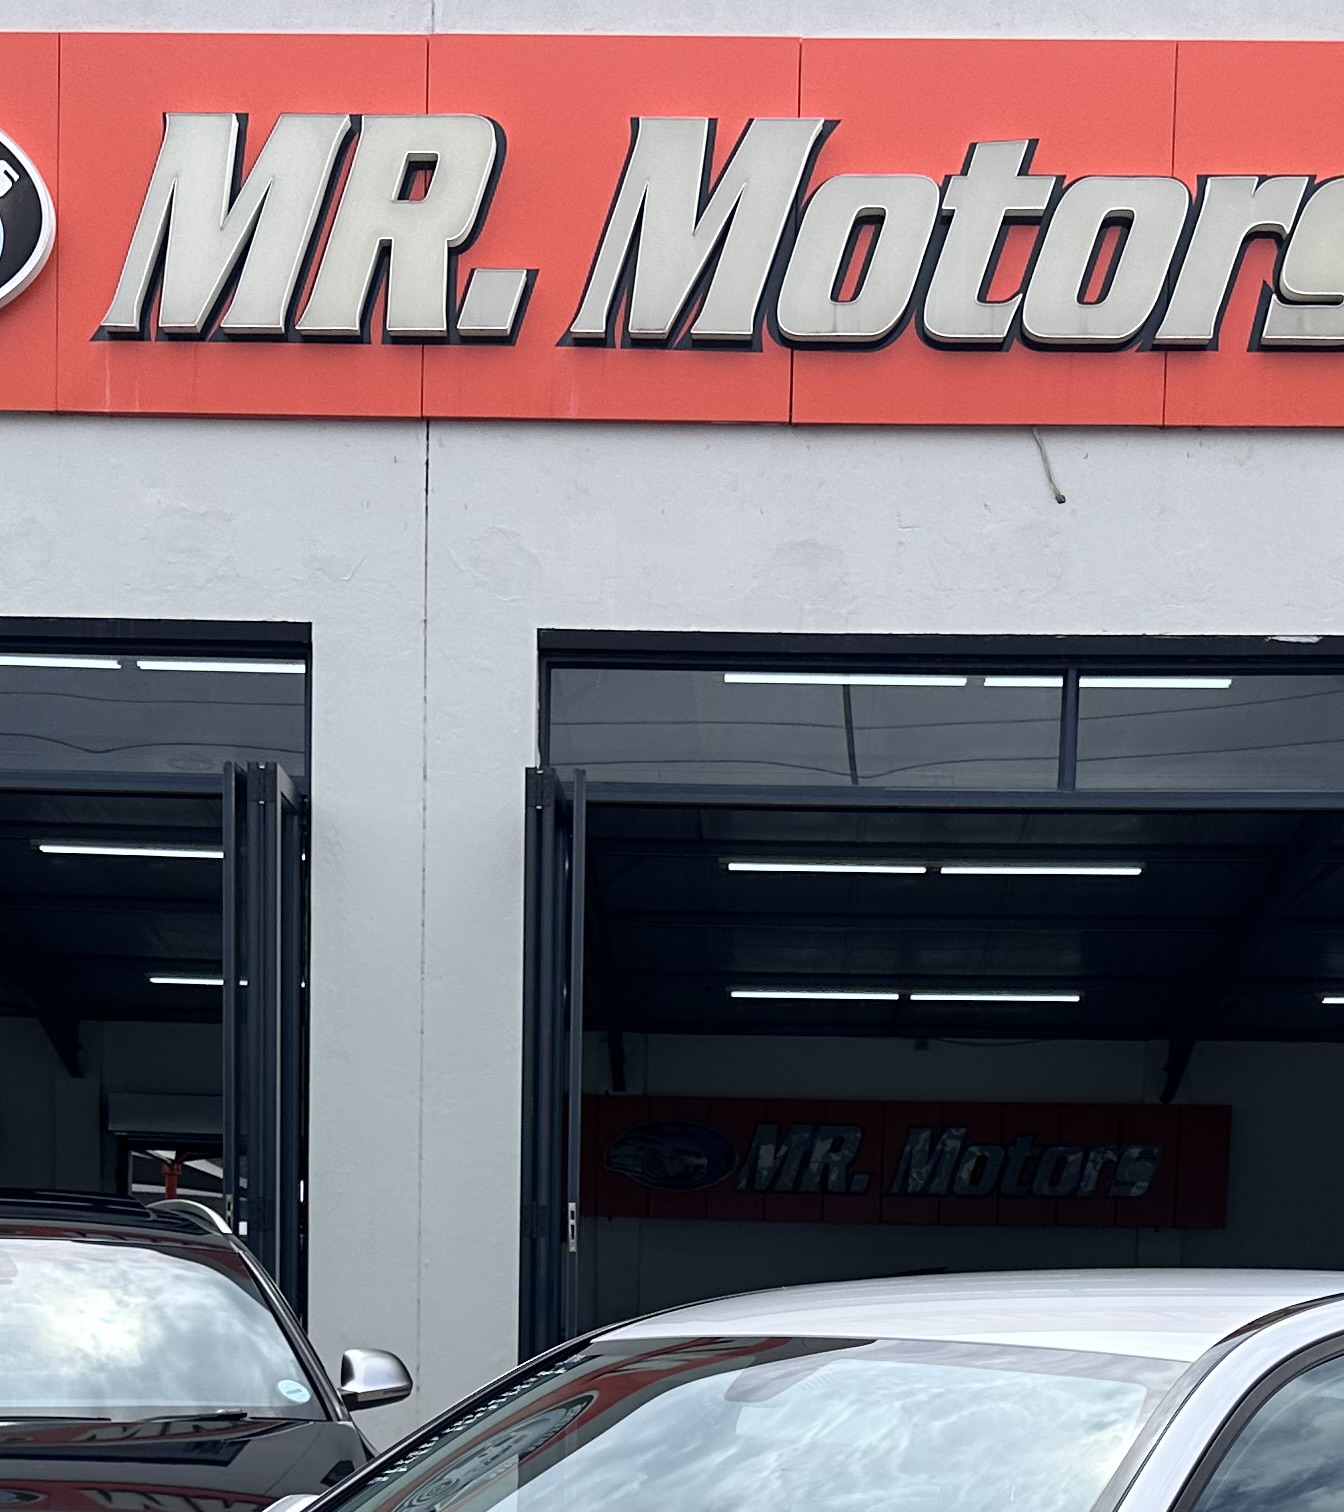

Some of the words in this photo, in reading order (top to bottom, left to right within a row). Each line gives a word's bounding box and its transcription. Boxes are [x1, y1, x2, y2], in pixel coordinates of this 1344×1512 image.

[94, 112, 536, 342] MR.
[737, 1121, 871, 1195] MR.
[885, 1125, 1165, 1198] Motors
